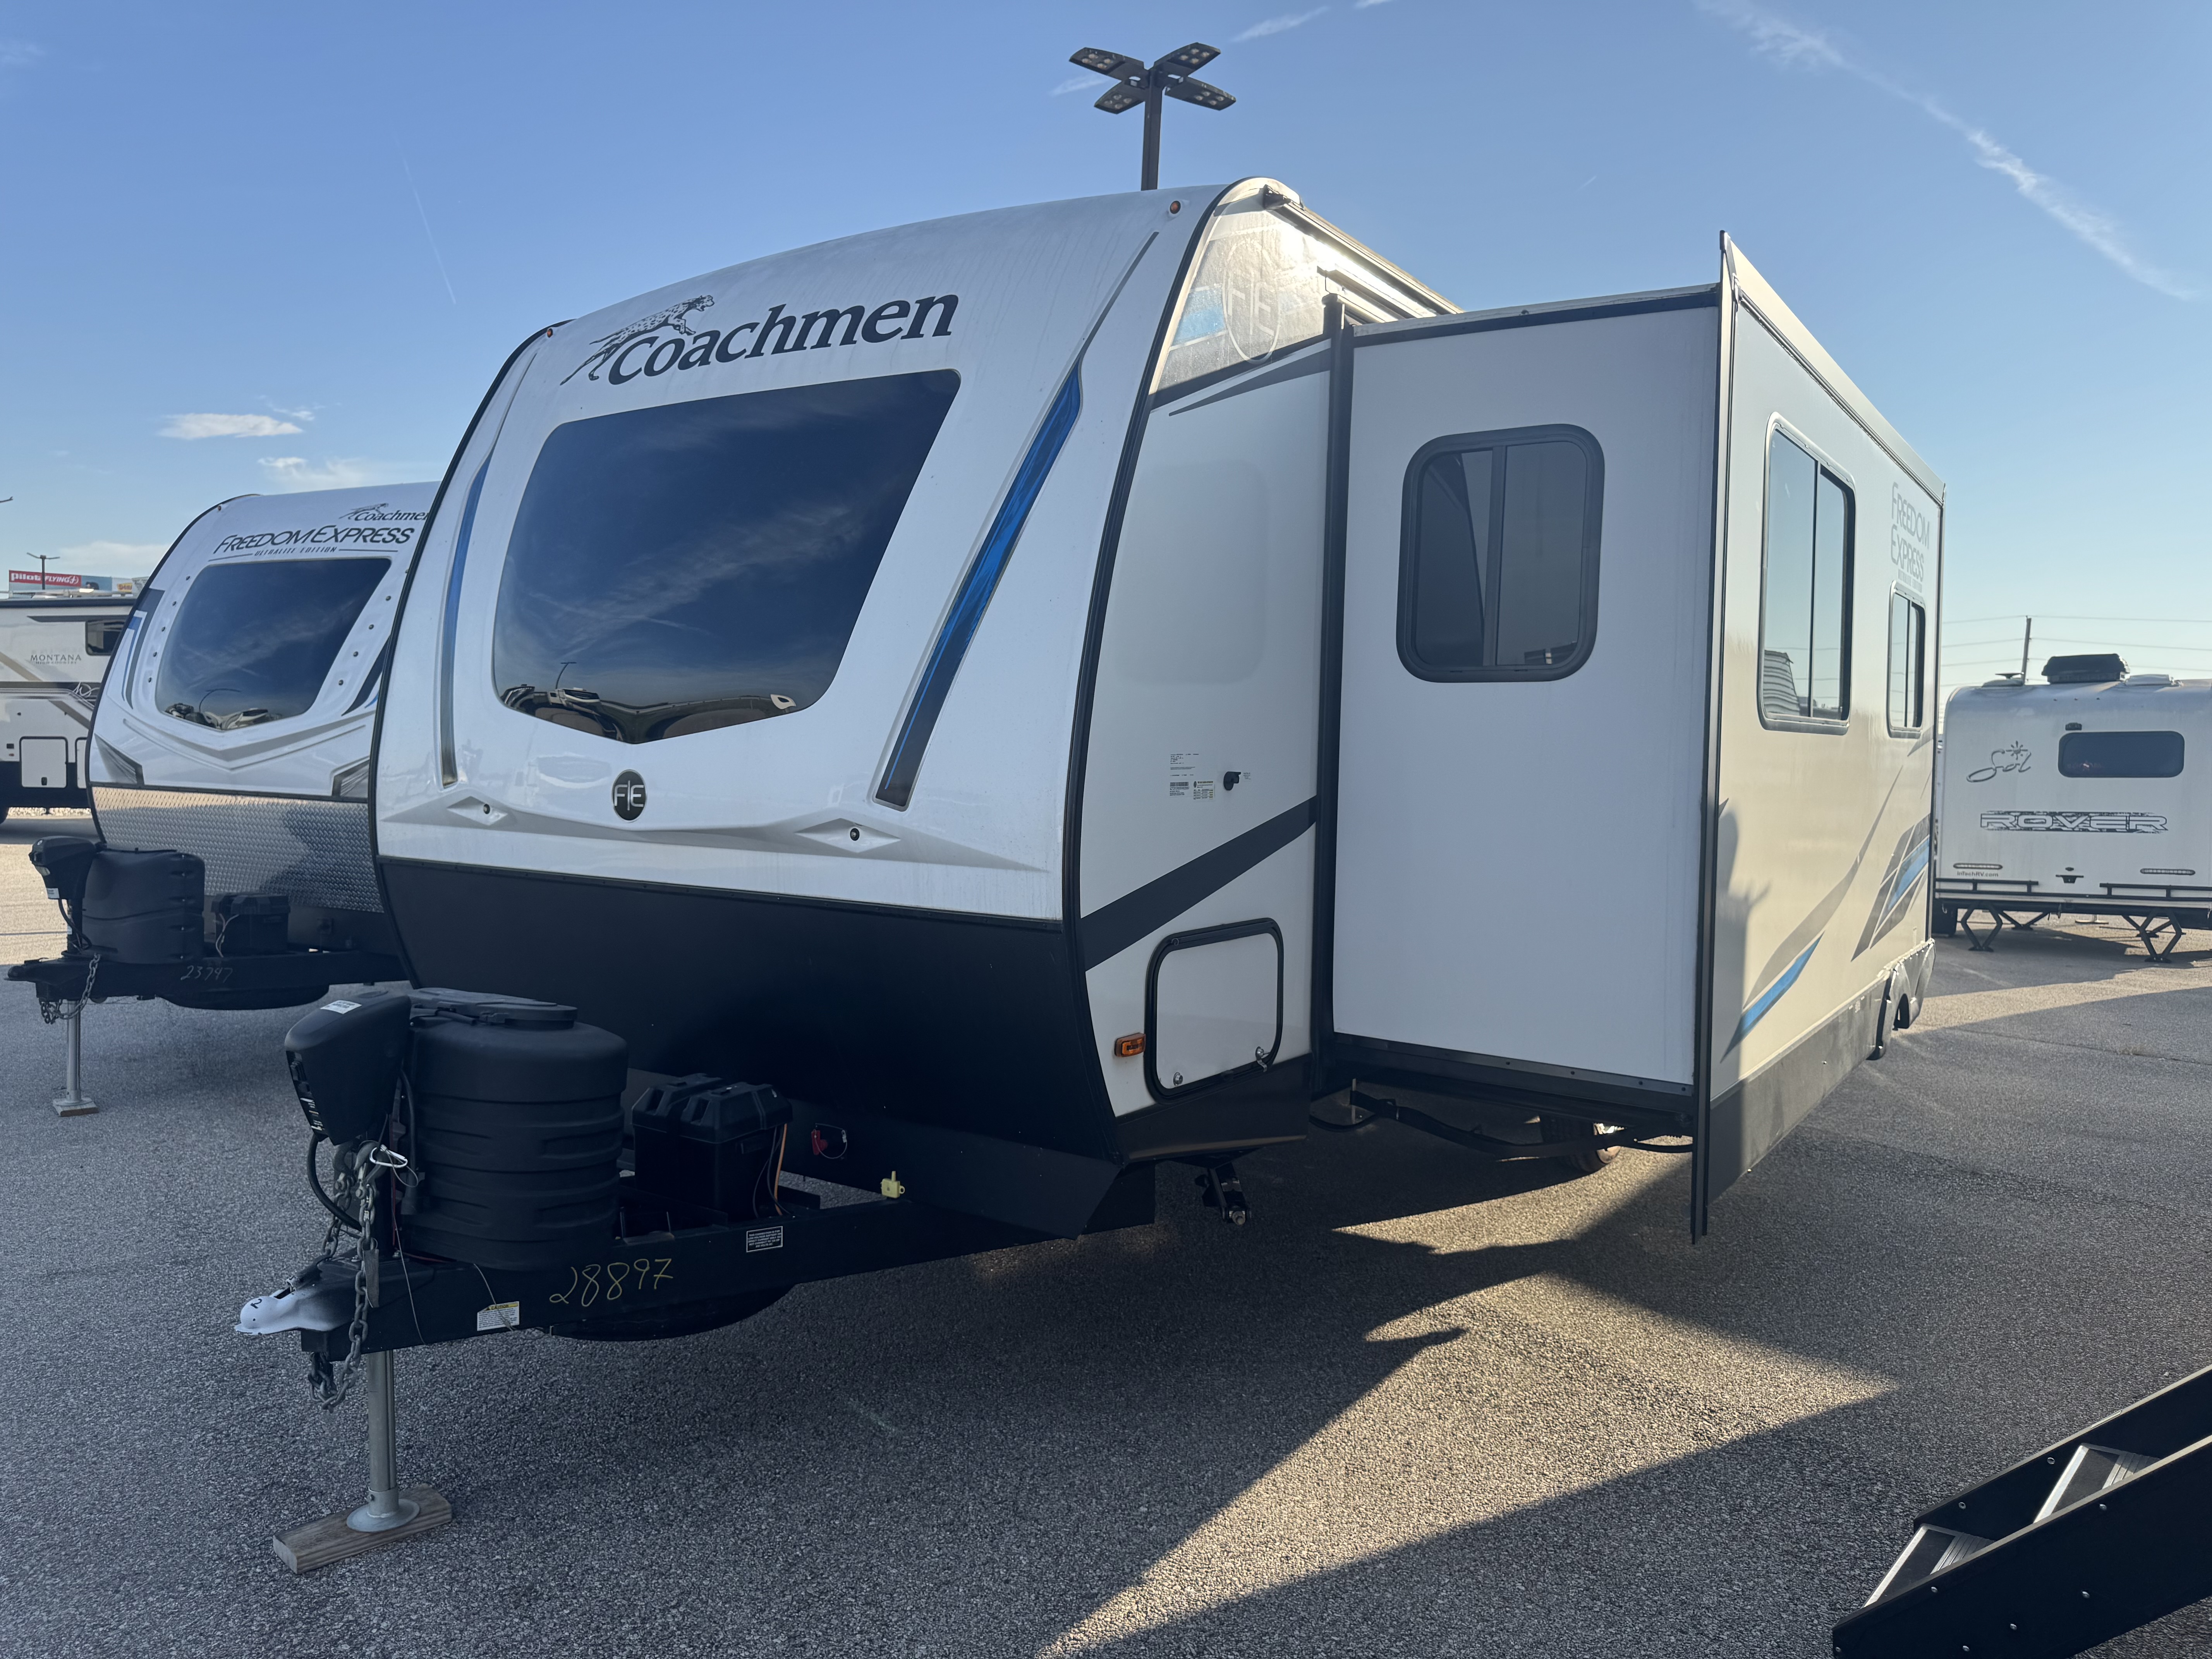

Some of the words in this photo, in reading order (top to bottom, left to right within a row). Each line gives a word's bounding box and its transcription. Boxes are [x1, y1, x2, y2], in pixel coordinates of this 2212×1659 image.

[608, 295, 958, 385] Coachmen
[1891, 481, 1930, 550] FREEDOM
[1891, 524, 1924, 582] EXPRESS
[1980, 812, 2168, 831] ROVER
[550, 1258, 673, 1307] 28897
